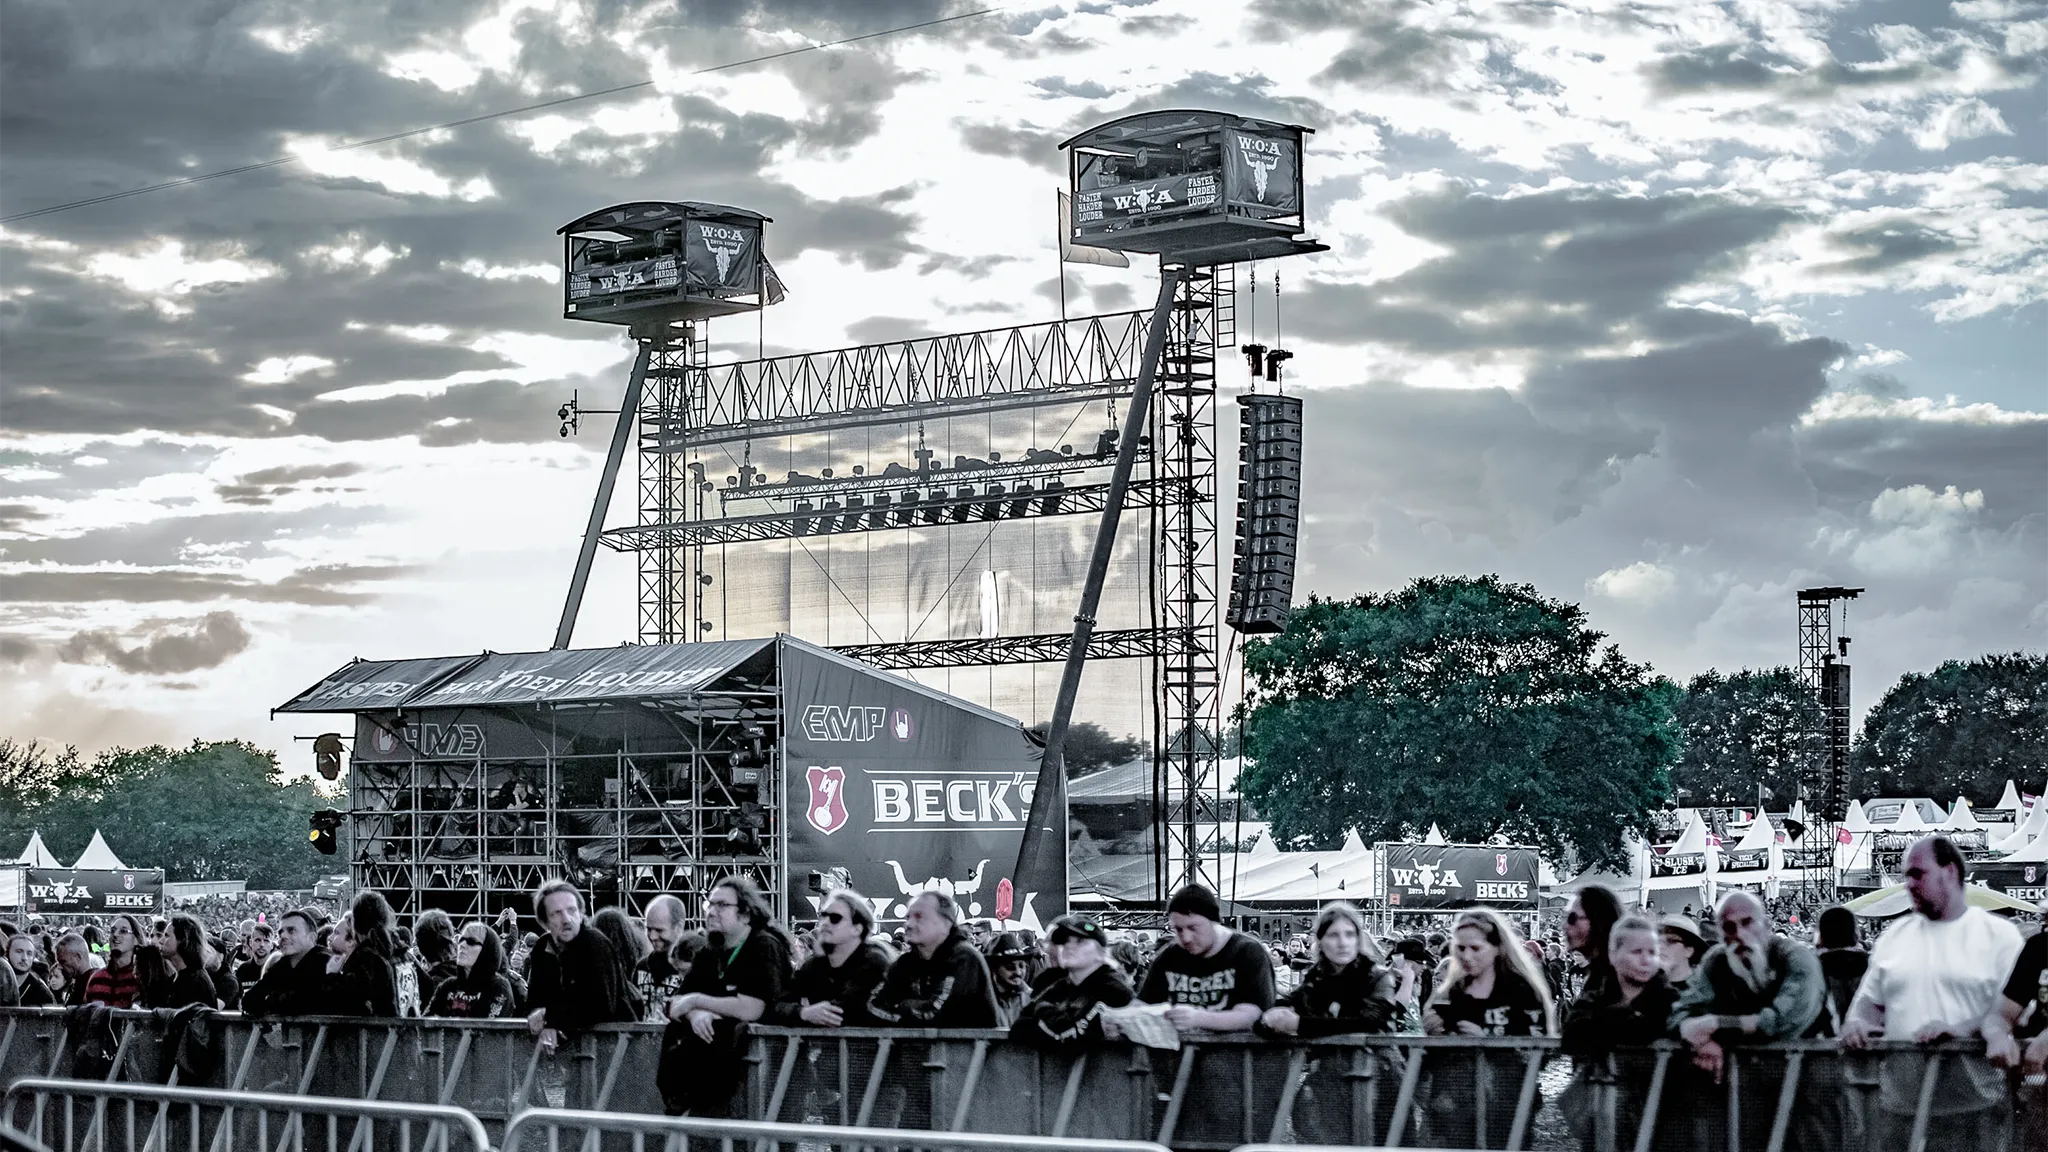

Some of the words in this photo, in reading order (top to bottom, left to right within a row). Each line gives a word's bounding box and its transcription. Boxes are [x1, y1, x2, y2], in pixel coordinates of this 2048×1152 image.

[1237, 135, 1282, 156] W:O:A
[1188, 175, 1214, 187] FASTER
[1187, 185, 1216, 197] HARDER
[1078, 192, 1102, 203] FASTER
[1187, 195, 1216, 207] LOUDER
[1078, 201, 1103, 213] HARDER
[1079, 211, 1104, 222] LOUDER
[699, 225, 745, 242] W:O:A
[655, 260, 676, 271] FASTER
[654, 268, 678, 279] HARDER
[654, 277, 677, 288] LOUDER
[801, 705, 886, 742] EMP
[1665, 856, 1695, 867] SLUSH
[1672, 866, 1688, 875] ICE
[1429, 887, 1446, 895] 1990
[1476, 882, 1528, 899] BECK'S
[106, 894, 154, 906] BECK'S
